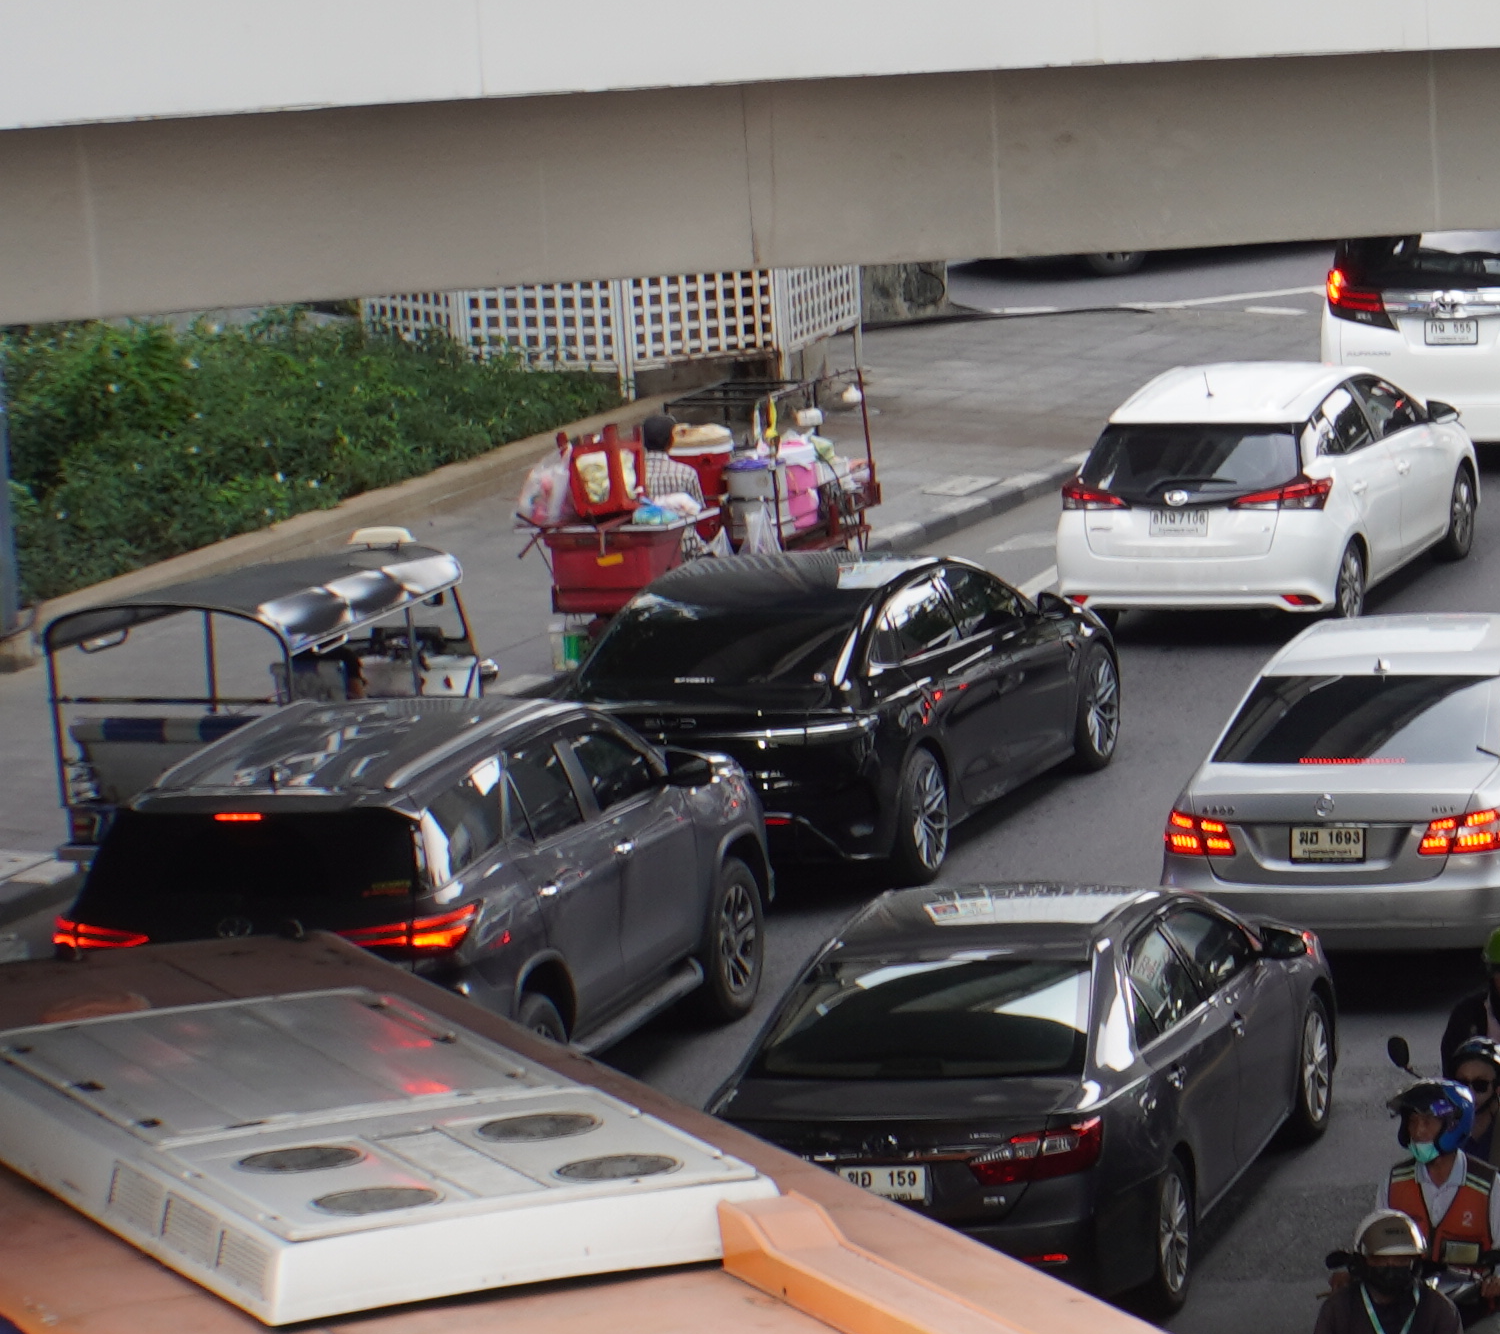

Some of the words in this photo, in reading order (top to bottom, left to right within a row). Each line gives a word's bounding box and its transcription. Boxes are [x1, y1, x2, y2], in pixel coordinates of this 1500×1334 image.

[1328, 830, 1361, 845] 1693
[888, 1170, 917, 1187] 159
[1461, 1212, 1471, 1226] 2
